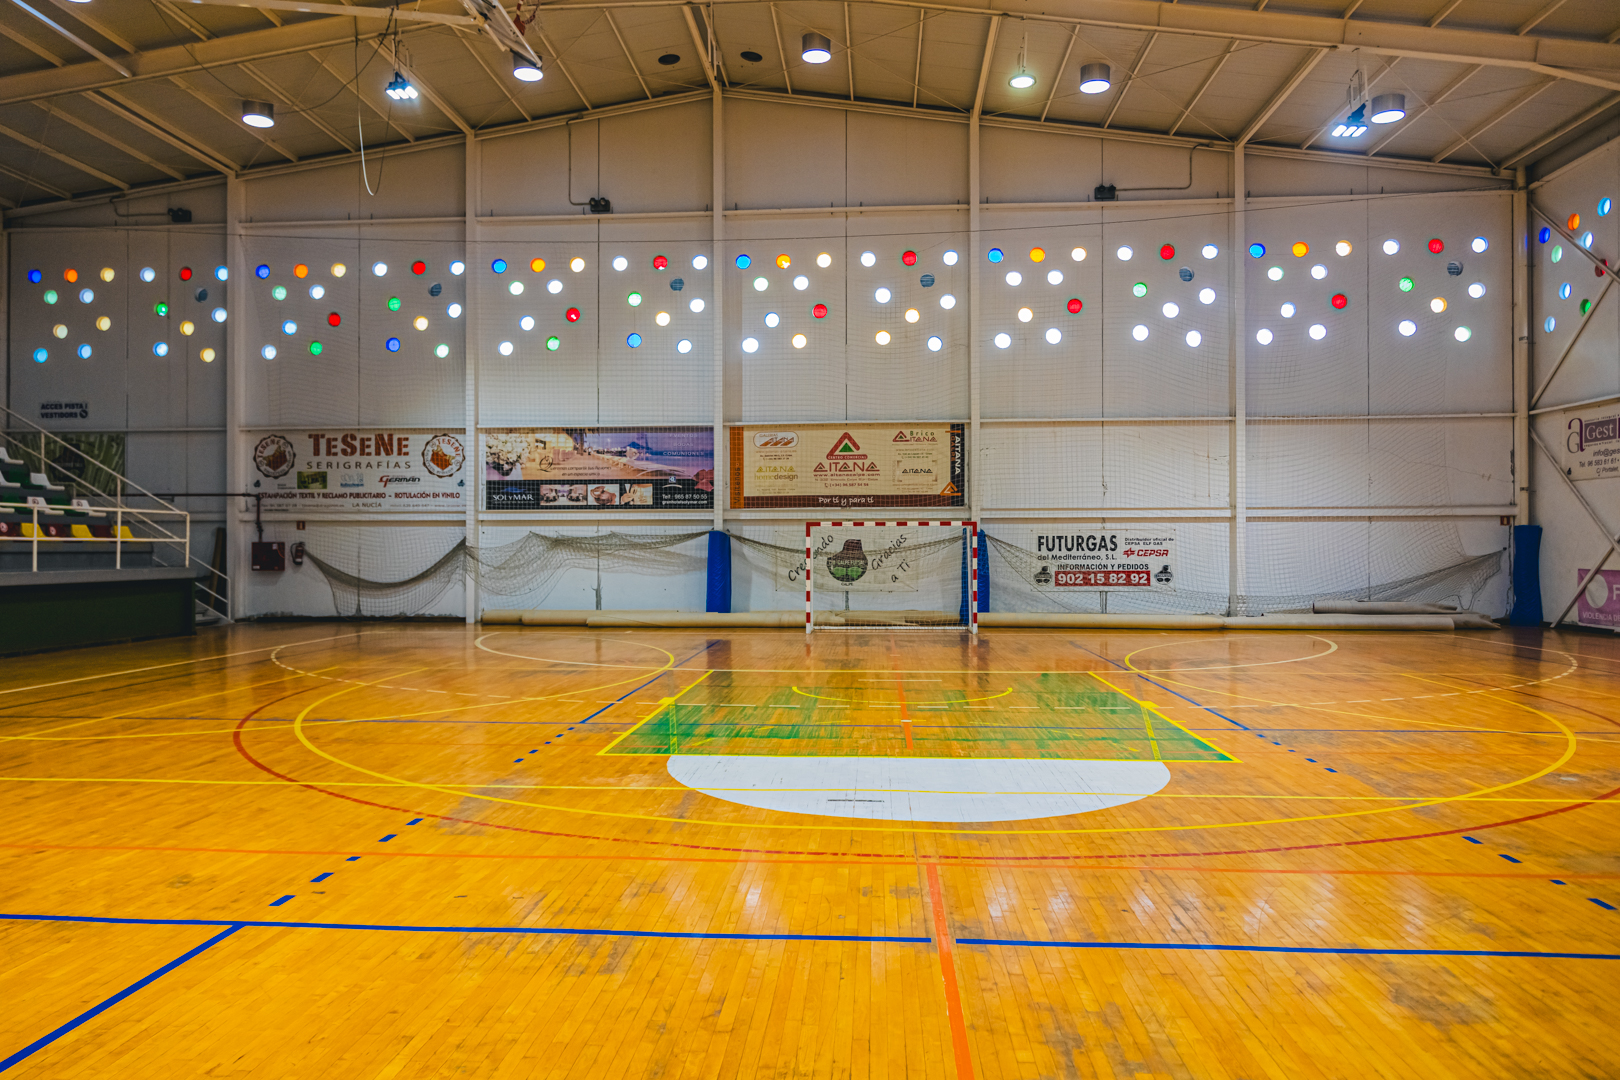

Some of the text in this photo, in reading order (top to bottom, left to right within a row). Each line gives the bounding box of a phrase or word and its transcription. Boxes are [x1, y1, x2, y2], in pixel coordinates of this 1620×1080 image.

[1586, 422, 1614, 440] Gest
[307, 460, 411, 469] SERIGRAFÍAS
[813, 461, 881, 472] AITANA
[395, 491, 430, 499] ROTULACIÓN
[1037, 535, 1118, 552] FUTURGAS
[871, 534, 907, 570] Gracias
[1051, 553, 1103, 561] Mediterráneo,
[1105, 553, 1117, 561] S.L.
[1136, 549, 1169, 557] CEPSA
[788, 534, 834, 582] Creendo
[891, 558, 911, 583] a Ti
[1057, 573, 1084, 584] 902
[1088, 573, 1105, 584] 15
[1108, 573, 1127, 584] 82
[1130, 573, 1148, 584] 92
[1582, 612, 1613, 621] VIOLENCIA
